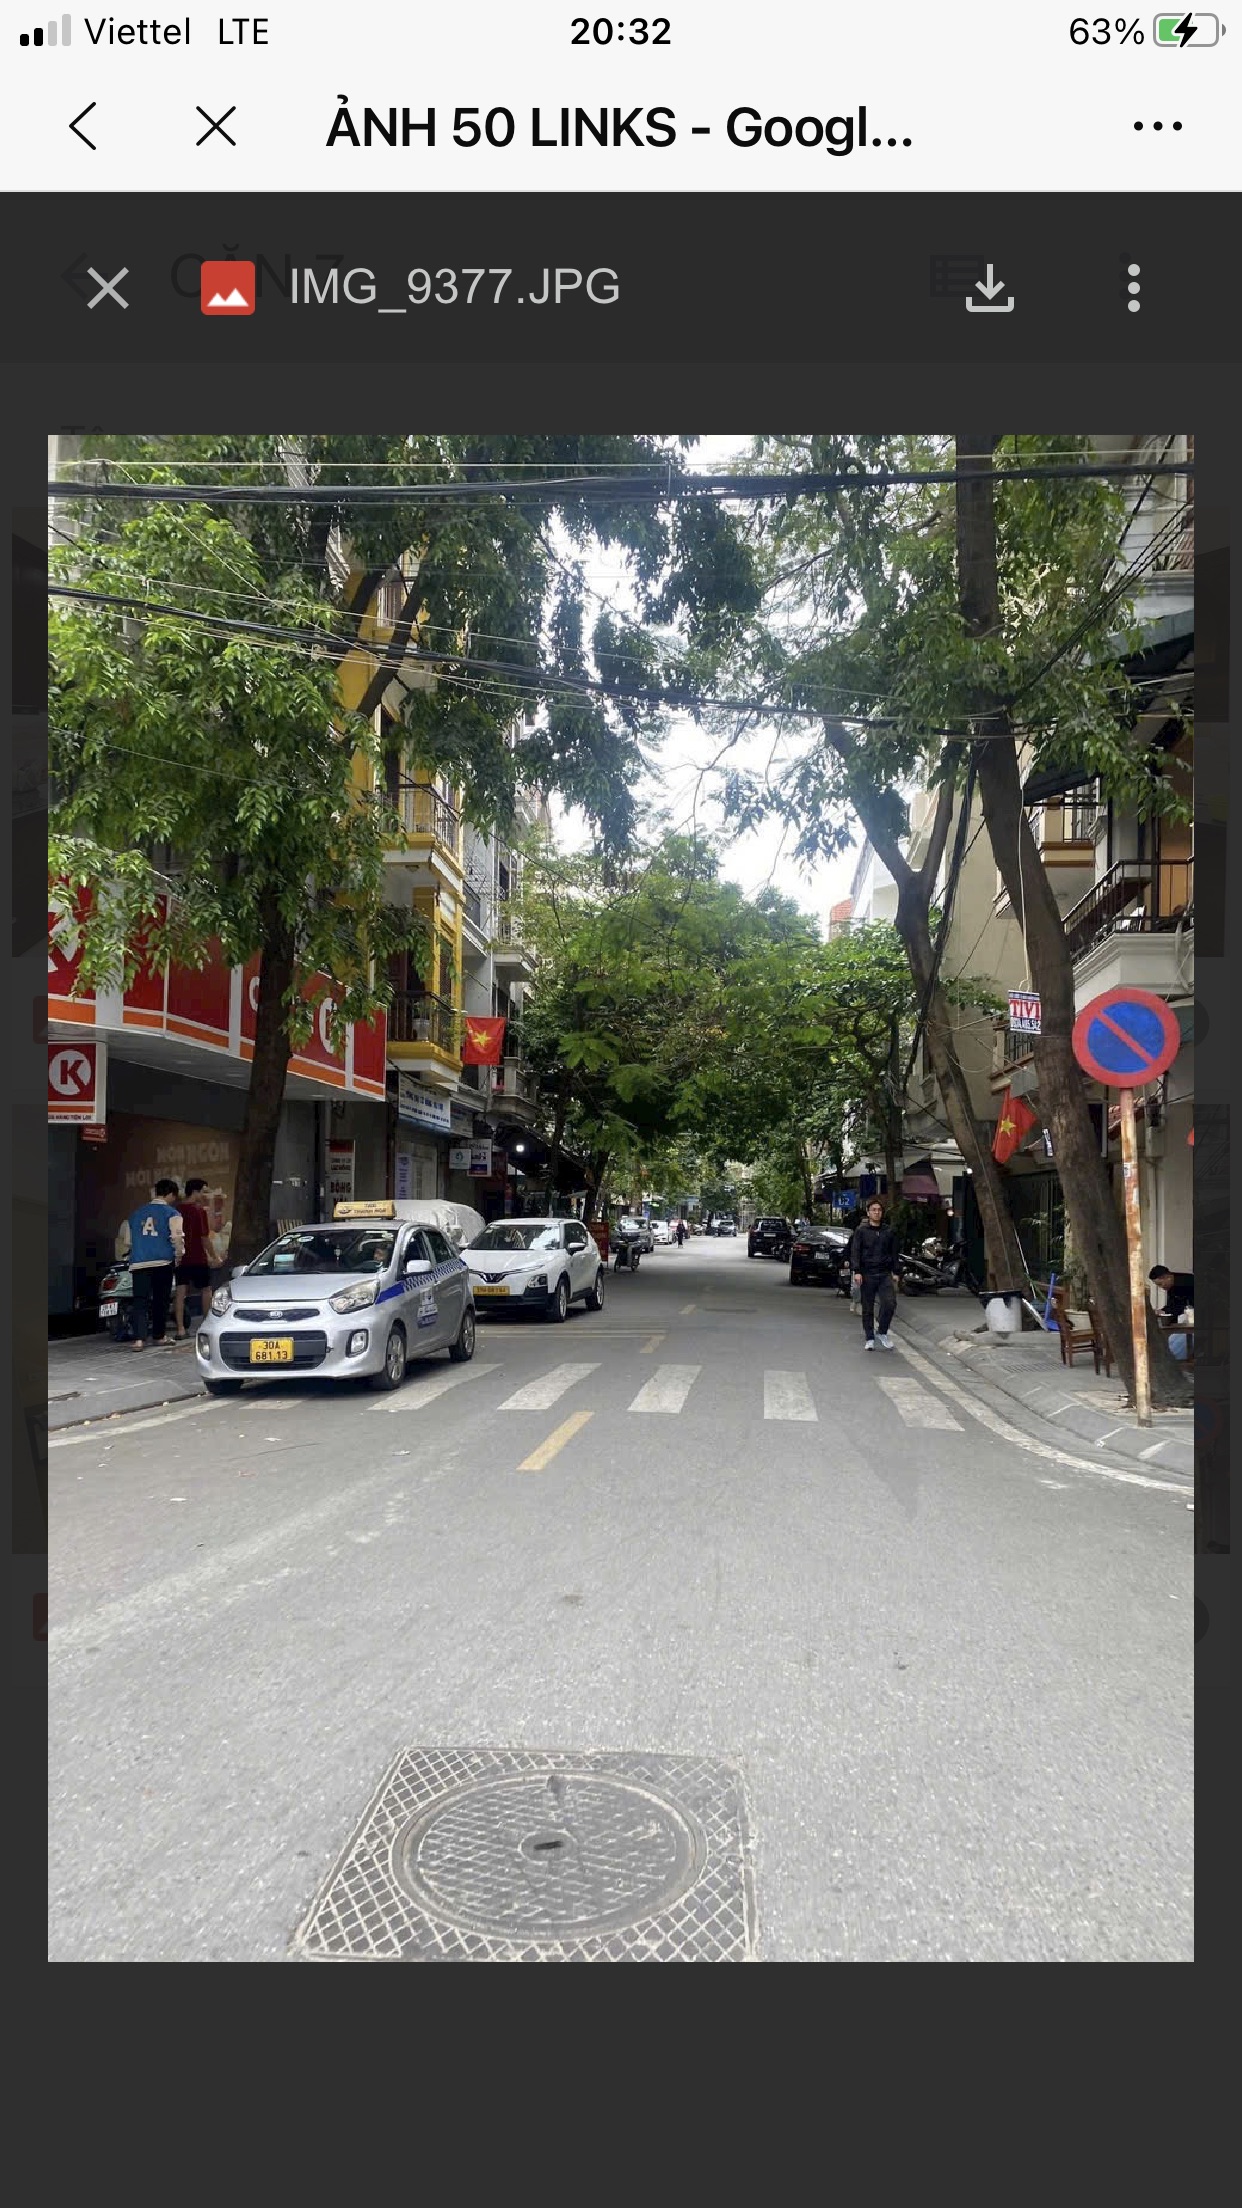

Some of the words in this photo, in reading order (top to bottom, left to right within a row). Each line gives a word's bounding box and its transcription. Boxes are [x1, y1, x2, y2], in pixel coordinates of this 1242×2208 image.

[85, 17, 190, 44] Viettel
[220, 18, 268, 45] LTE
[571, 17, 670, 45] 20:32
[1070, 17, 1145, 45] 63%
[326, 95, 435, 147] ẢNH
[453, 107, 514, 147] 50
[533, 107, 676, 148] LINKS
[291, 267, 619, 313] IMG_9377.JPG
[1010, 999, 1041, 1020] TIVI
[142, 1216, 158, 1237] A
[262, 1341, 281, 1350] 30A
